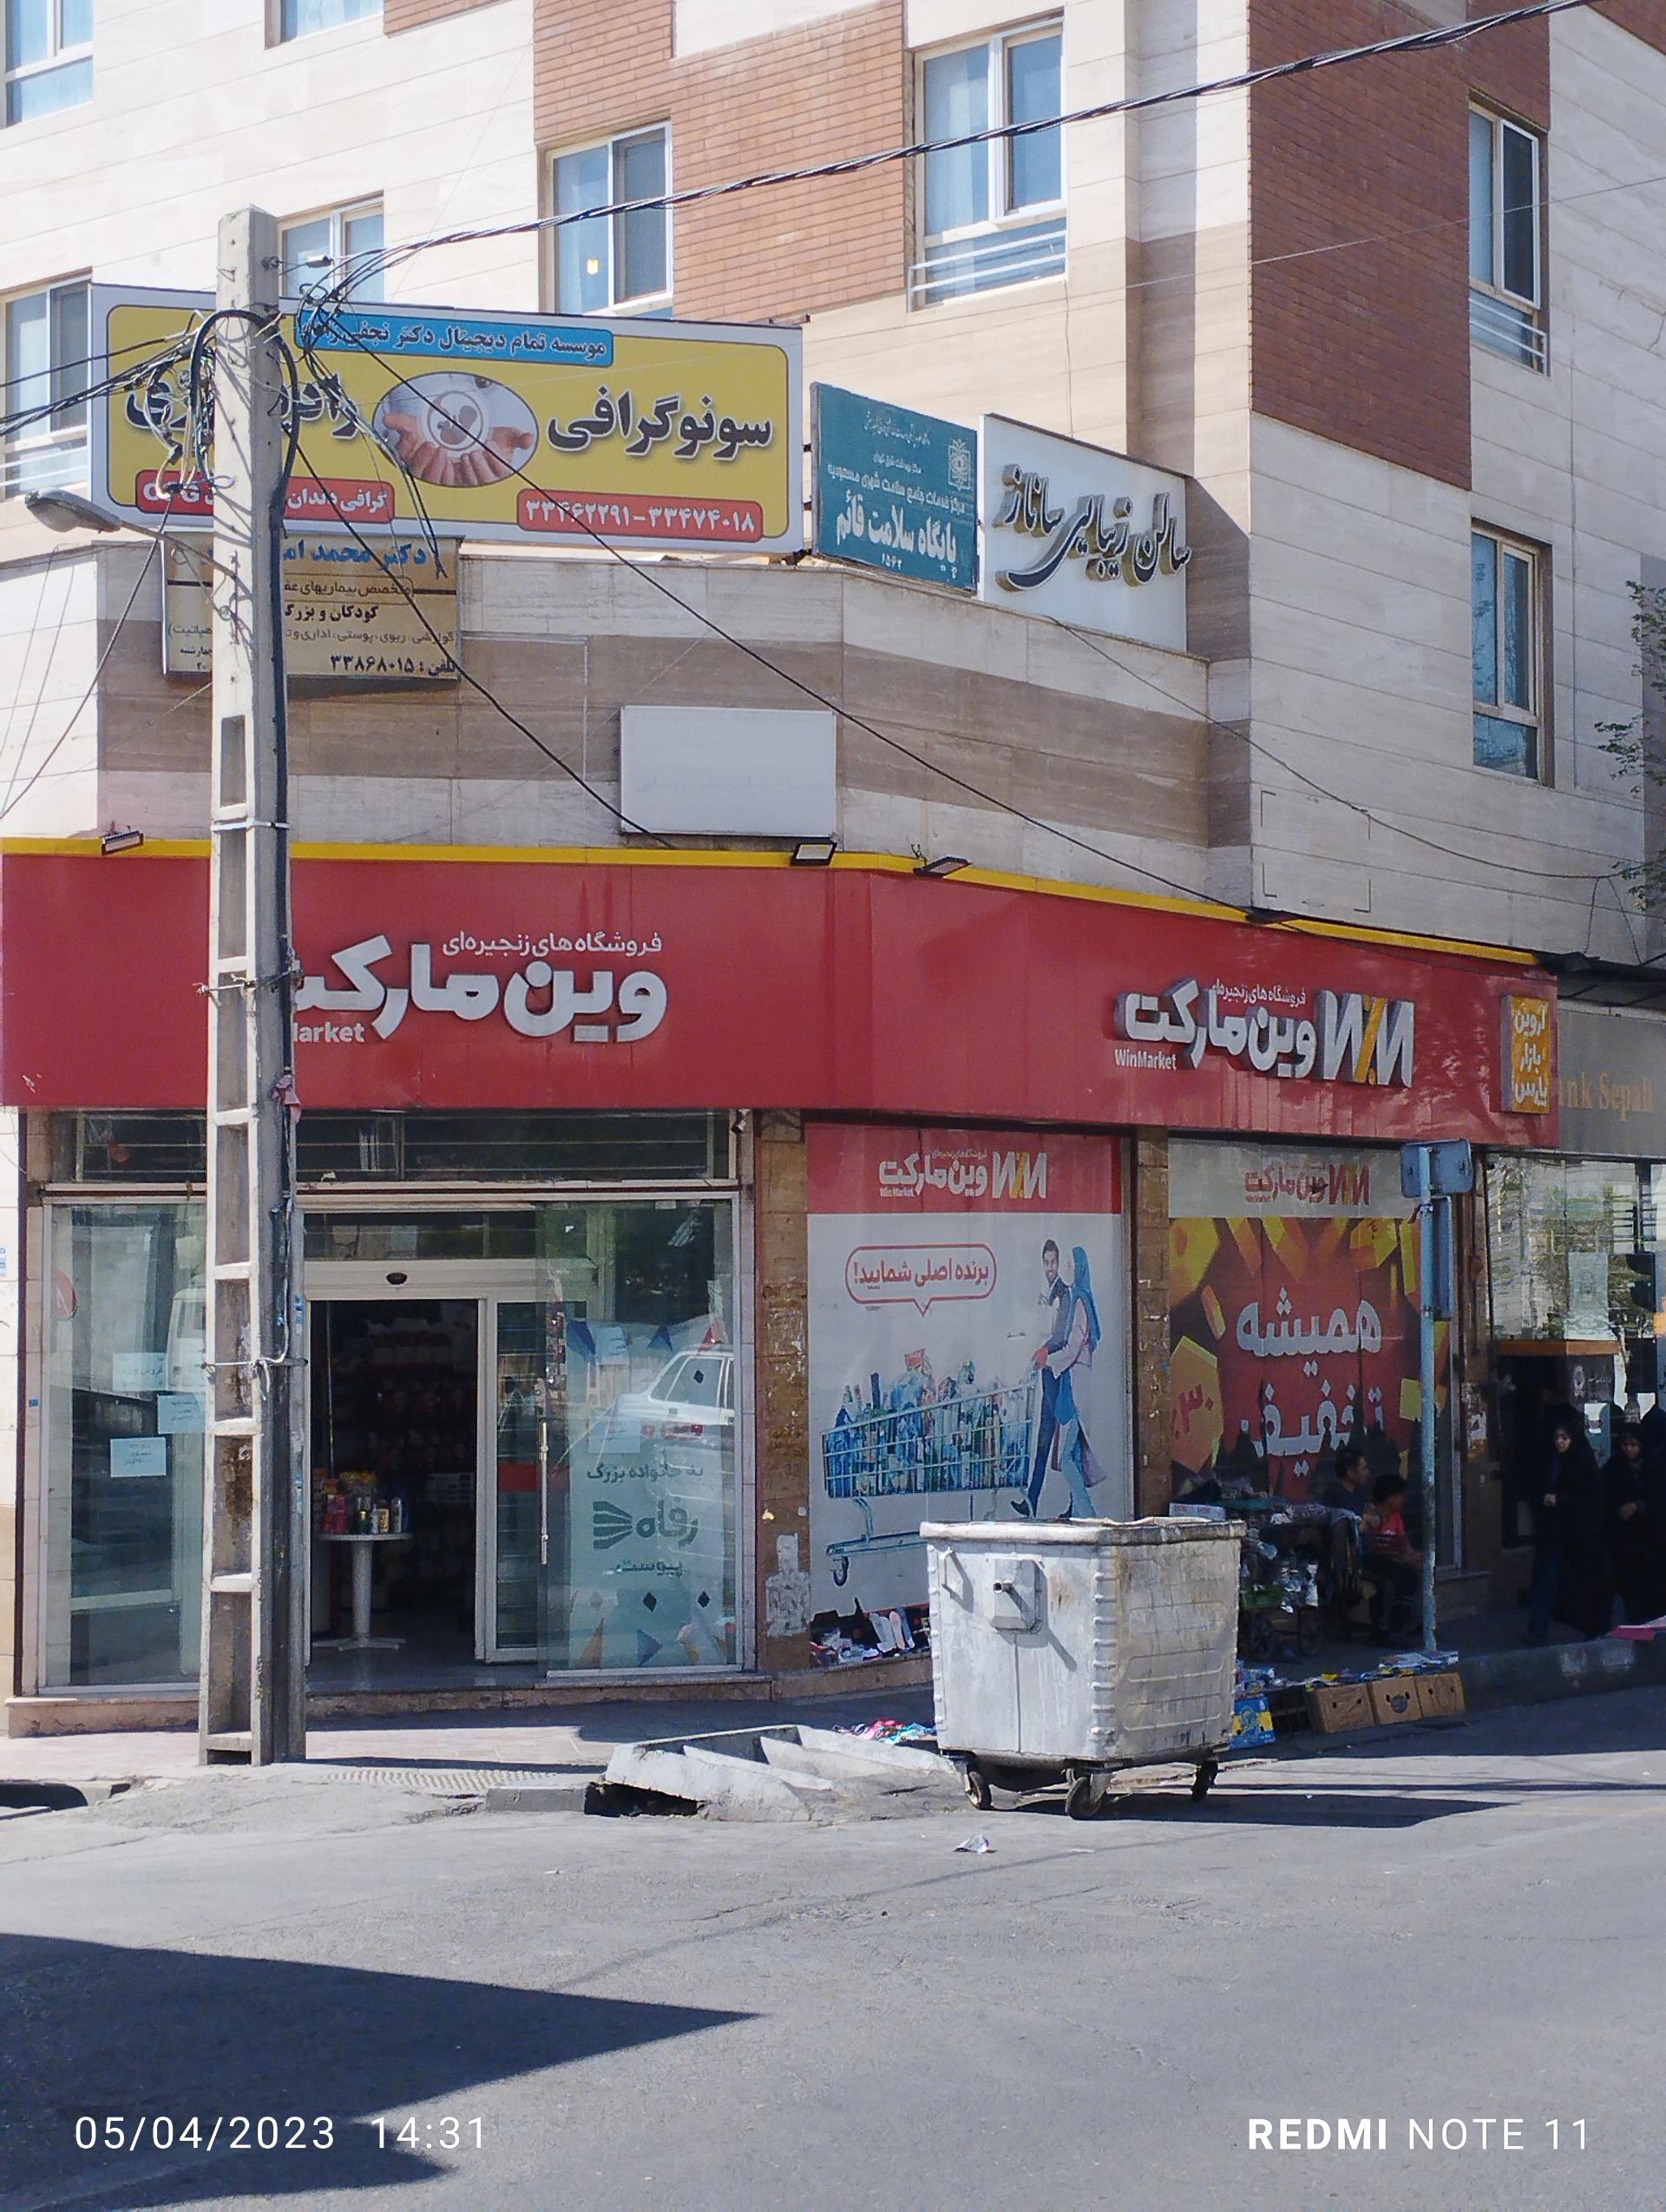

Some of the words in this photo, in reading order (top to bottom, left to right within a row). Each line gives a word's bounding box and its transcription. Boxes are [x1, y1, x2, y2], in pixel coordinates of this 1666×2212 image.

[394, 324, 434, 348] دکتر
[439, 324, 506, 354] دیجیتال
[511, 332, 547, 357] تمام
[547, 386, 773, 461] سونوگرافی
[286, 488, 338, 509] دندان
[994, 465, 1066, 539] ساناز
[869, 505, 915, 552] سلامت
[918, 516, 958, 579] پایگاه
[1128, 491, 1192, 586] سالن
[311, 543, 373, 564] محمد
[384, 543, 427, 571] دکتر
[318, 609, 326, 622] و
[331, 605, 379, 623] کودکان
[574, 931, 664, 958] فروشگاه
[295, 934, 500, 1039] مارک
[504, 959, 667, 1043] وین
[1122, 978, 1248, 1070] مارکت
[1250, 1005, 1317, 1079] وین
[1598, 1072, 1653, 1122] Sepah
[879, 1151, 948, 1196] مارکت
[948, 1159, 988, 1197] وین
[914, 1258, 952, 1287] اصلی
[955, 1260, 989, 1287] برنده
[1236, 1286, 1383, 1378] همیشه
[587, 1462, 626, 1484] بزرگ
[636, 1496, 699, 1548] رفاه
